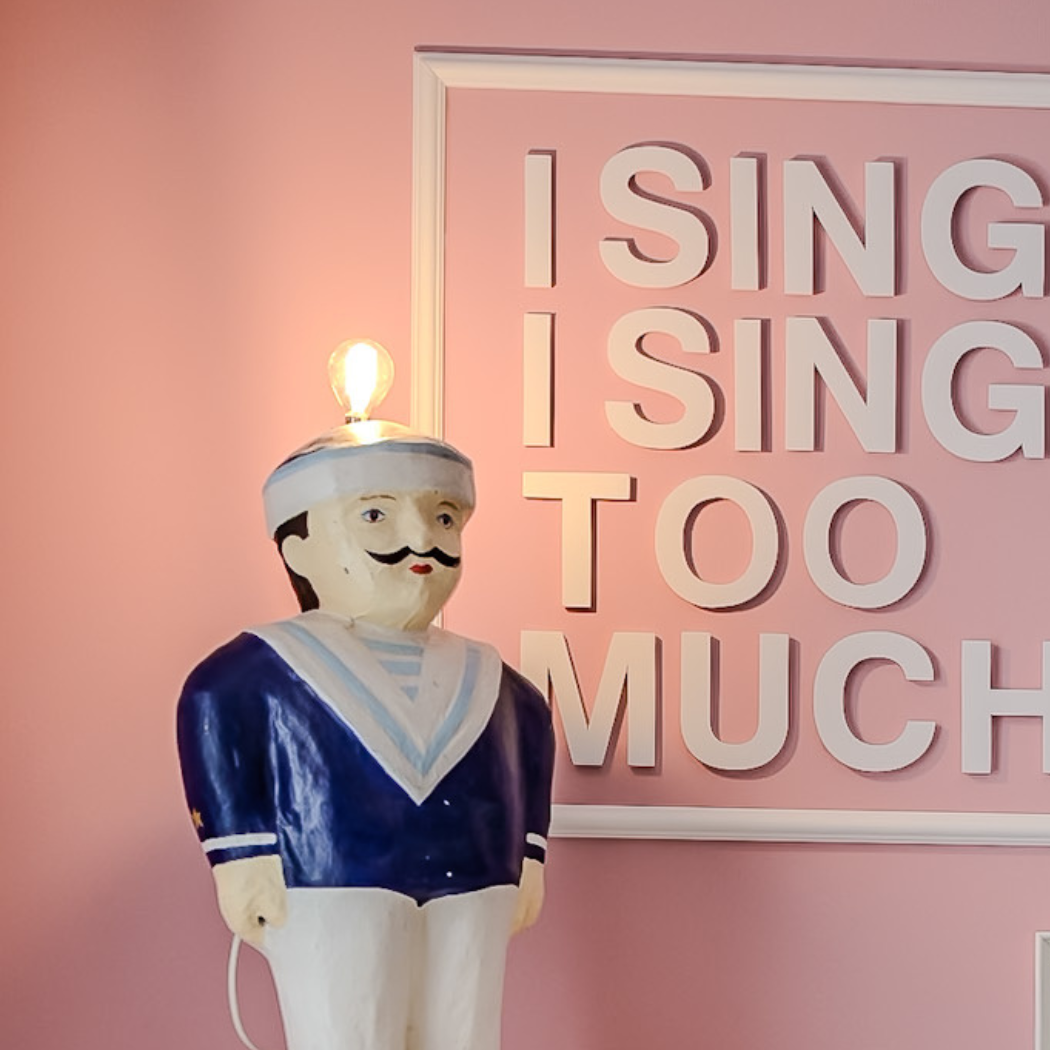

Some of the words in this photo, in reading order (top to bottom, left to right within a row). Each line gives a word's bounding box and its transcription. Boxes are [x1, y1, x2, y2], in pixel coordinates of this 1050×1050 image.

[525, 150, 555, 288] I
[599, 144, 1047, 301] SING
[523, 312, 554, 447] I
[604, 307, 1047, 462] SING
[522, 472, 930, 610] TOO
